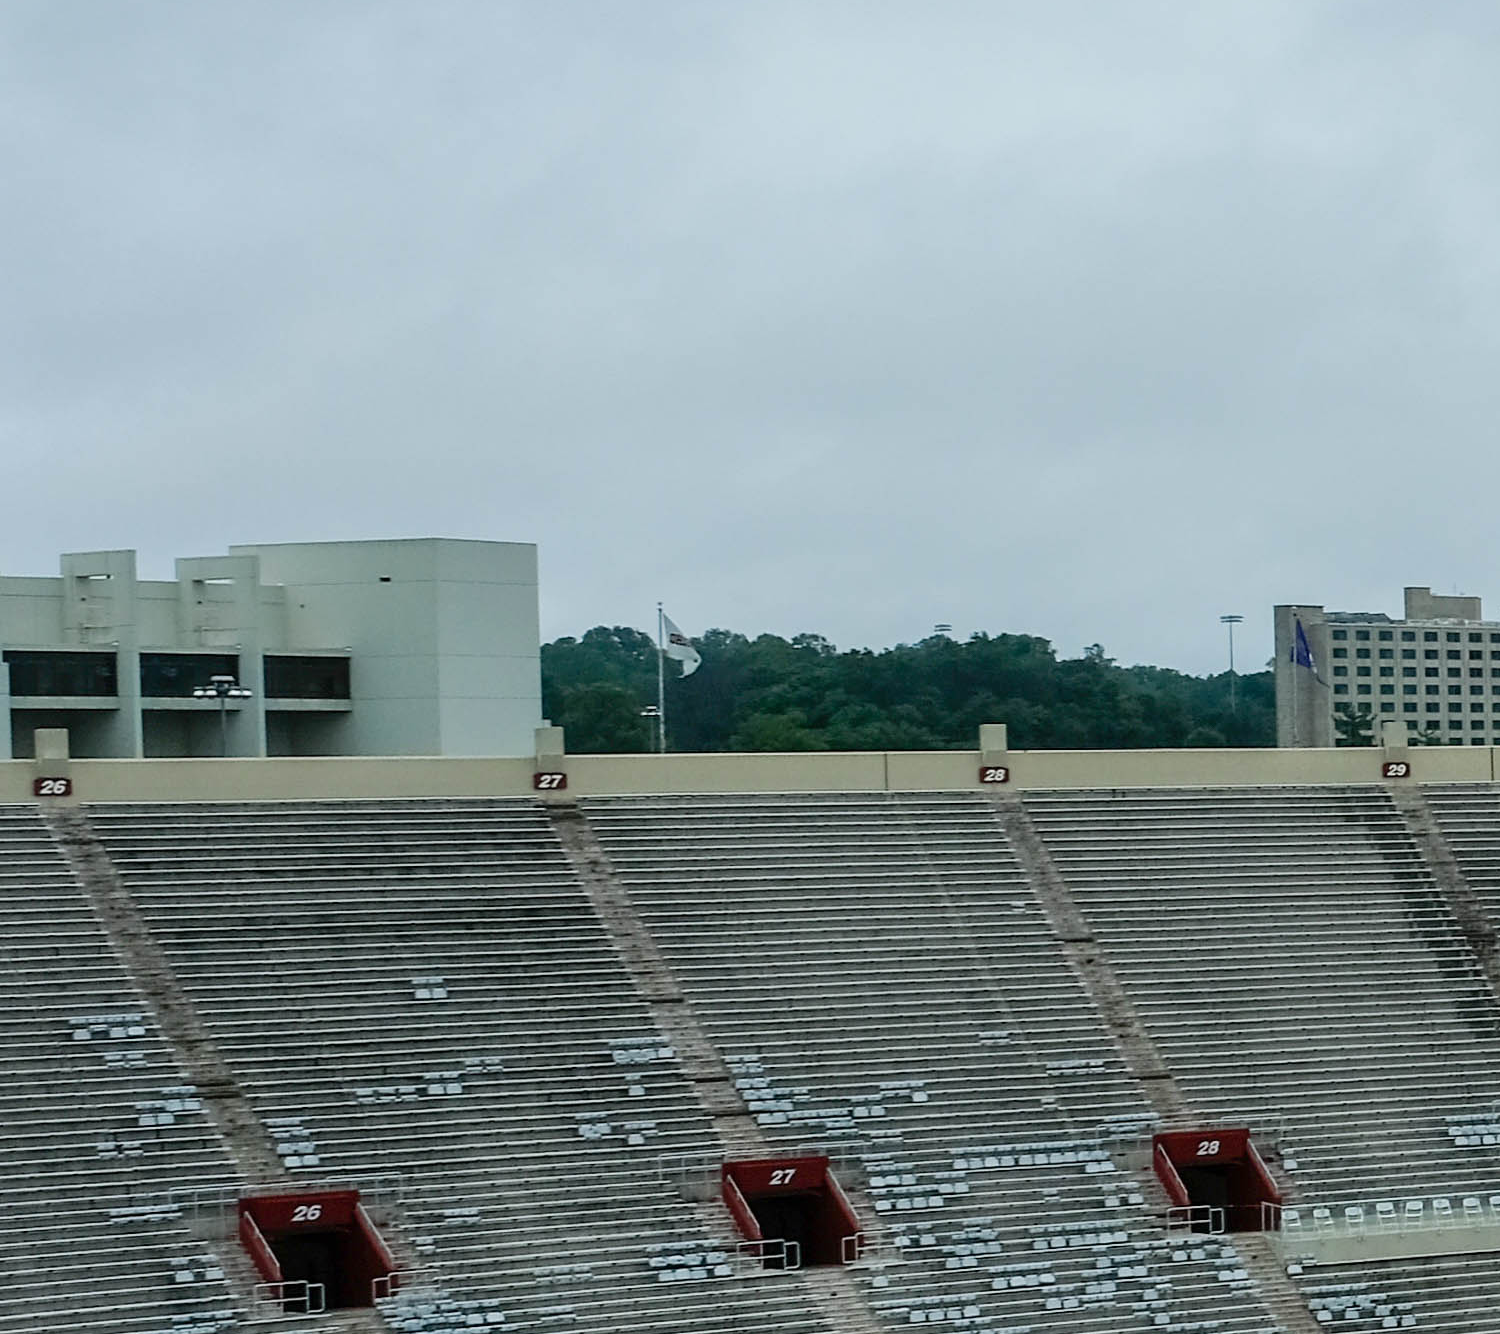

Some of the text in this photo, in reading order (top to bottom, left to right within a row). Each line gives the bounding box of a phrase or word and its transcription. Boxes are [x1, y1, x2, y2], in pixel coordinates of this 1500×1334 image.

[984, 769, 1005, 781] 28
[1387, 765, 1406, 776] 29
[40, 781, 66, 794] 26
[539, 775, 561, 787] 27
[1196, 1140, 1220, 1155] 28
[769, 1169, 795, 1185] 27
[292, 1205, 322, 1222] 26
